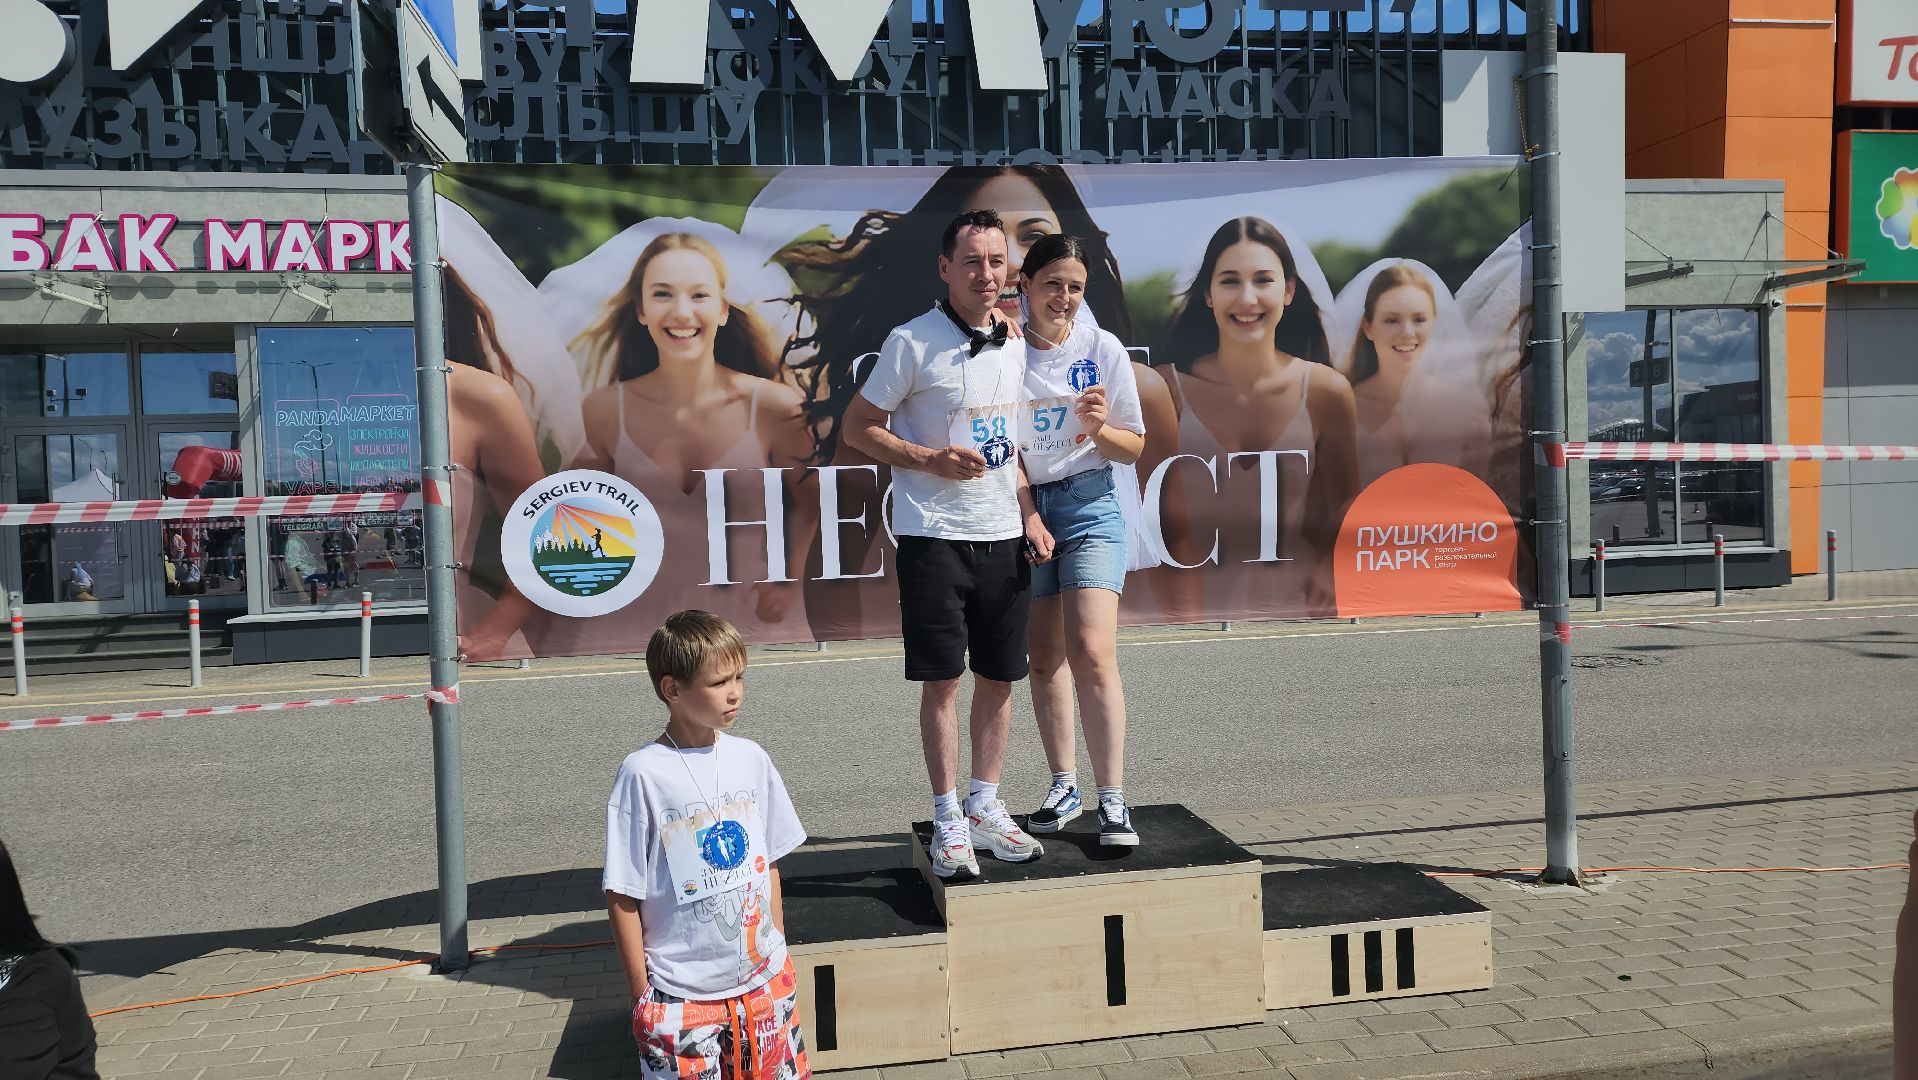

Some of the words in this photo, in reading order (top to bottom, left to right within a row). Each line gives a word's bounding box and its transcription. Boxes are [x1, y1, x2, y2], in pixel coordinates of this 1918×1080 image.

[1105, 66, 1352, 120] МАСКА
[466, 91, 764, 146] СЛЫШУ
[0, 213, 179, 272] БАК
[275, 410, 340, 427] PANDA
[339, 405, 415, 422] МАРКЕТ
[1033, 406, 1068, 432] 57
[971, 415, 1006, 443] 58
[353, 443, 408, 455] ЖИДКОСТИ
[284, 480, 337, 494] VAPE
[523, 481, 592, 519] SERGIEV
[596, 482, 639, 516] TRAIL
[281, 523, 324, 531] TELEGRAM
[692, 449, 1309, 587] НЕСТ
[1357, 521, 1498, 547] ПУШКИНО
[1356, 549, 1430, 572] ПАРК
